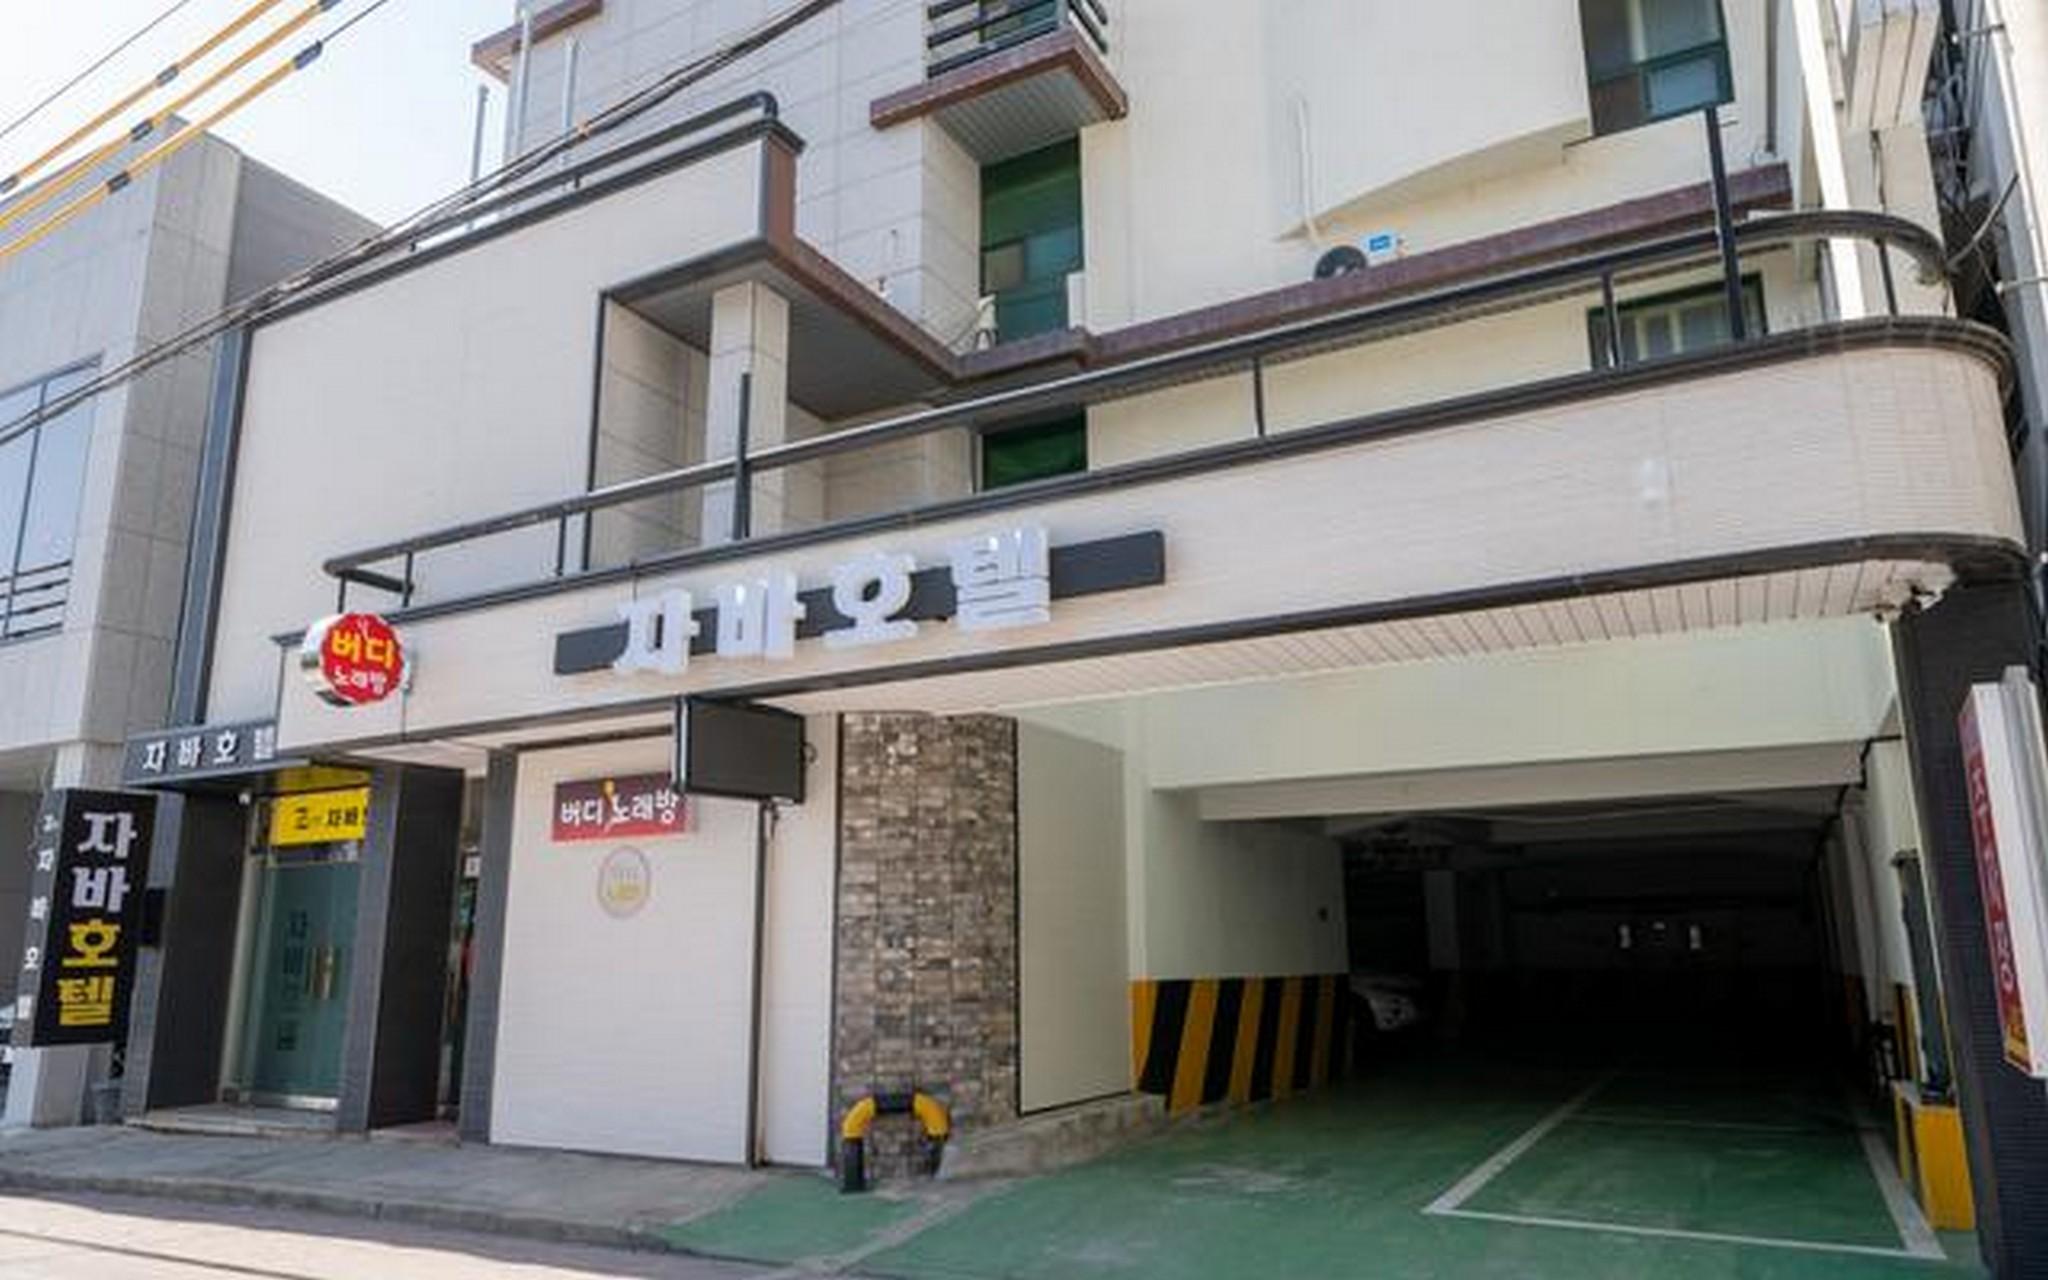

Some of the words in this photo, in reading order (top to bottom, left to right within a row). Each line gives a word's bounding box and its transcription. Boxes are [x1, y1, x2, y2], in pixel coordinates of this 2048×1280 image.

[614, 523, 1051, 675] 자바호텔
[331, 629, 395, 669] 버디
[335, 664, 388, 695] 노래방
[142, 725, 276, 773] 자바호텔
[561, 798, 603, 826] 버디
[605, 789, 680, 832] 노래방
[57, 811, 138, 1027] 자바호텔
